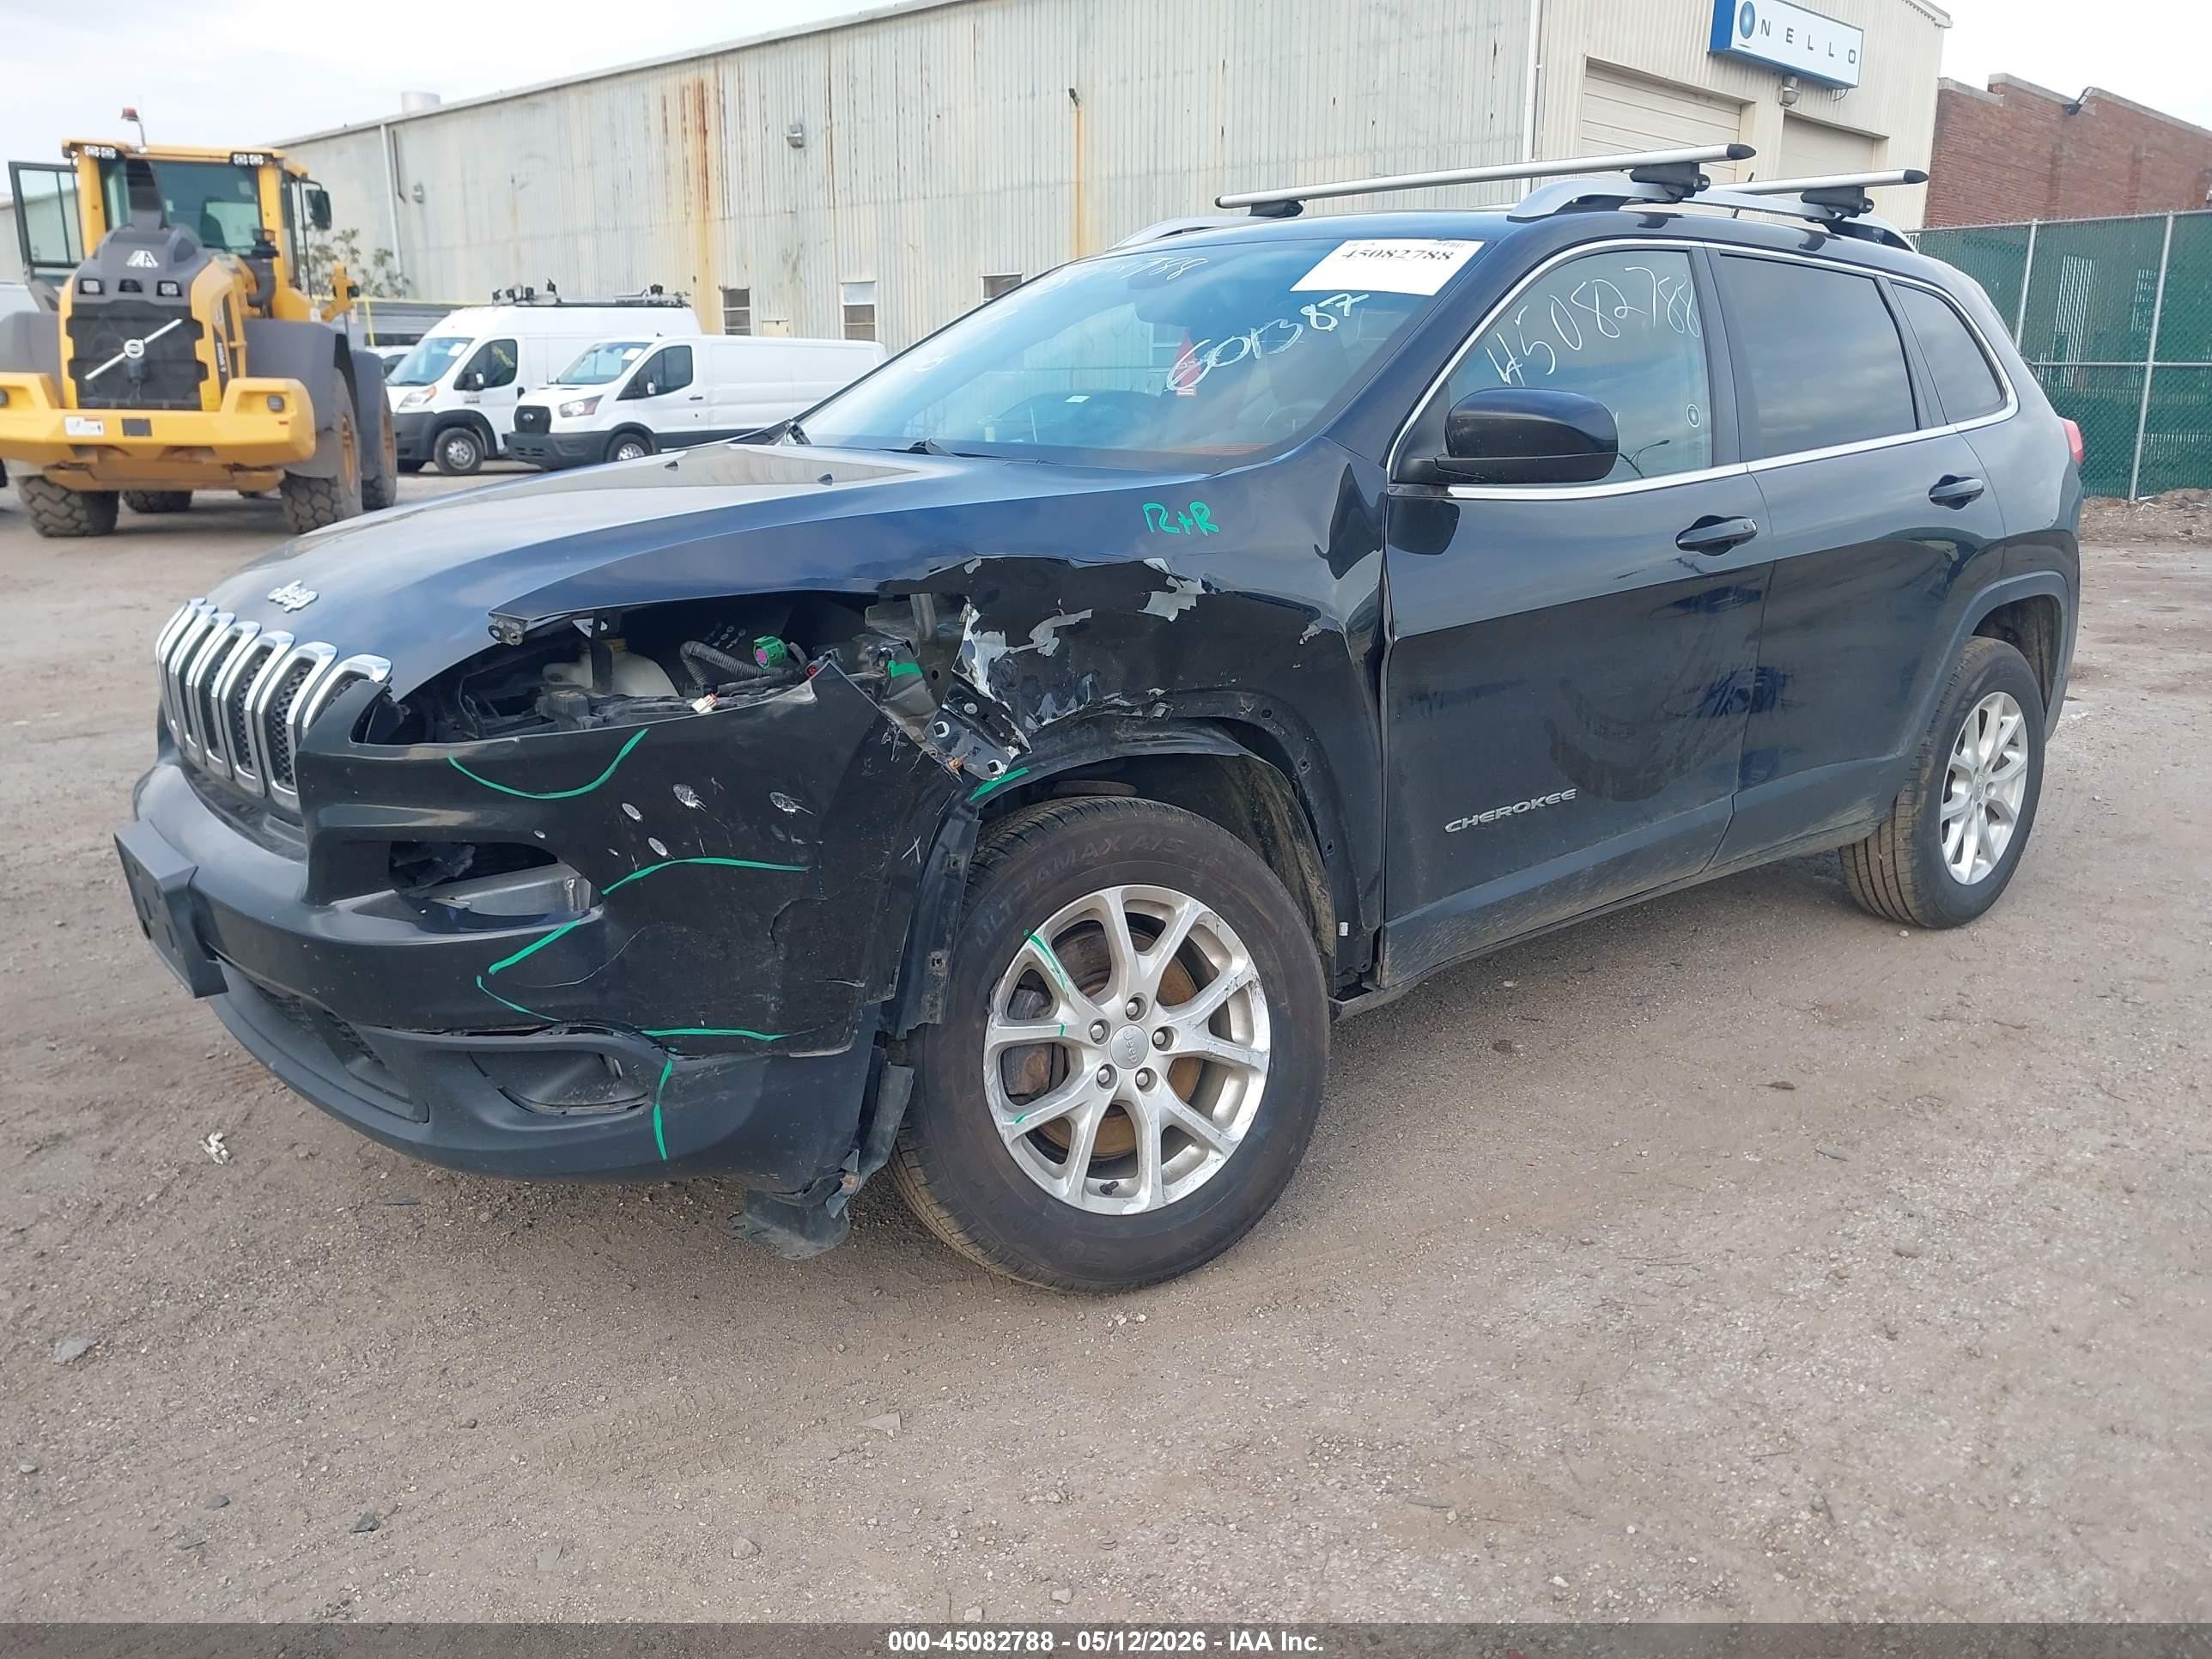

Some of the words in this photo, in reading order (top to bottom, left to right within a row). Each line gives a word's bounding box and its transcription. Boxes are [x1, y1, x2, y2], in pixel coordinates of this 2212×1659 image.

[1341, 248, 1455, 260] 45082788
[1485, 266, 1700, 387] 45082788
[1444, 787, 1577, 833] CHEROKEE
[1123, 1030, 1139, 1064] Jeep
